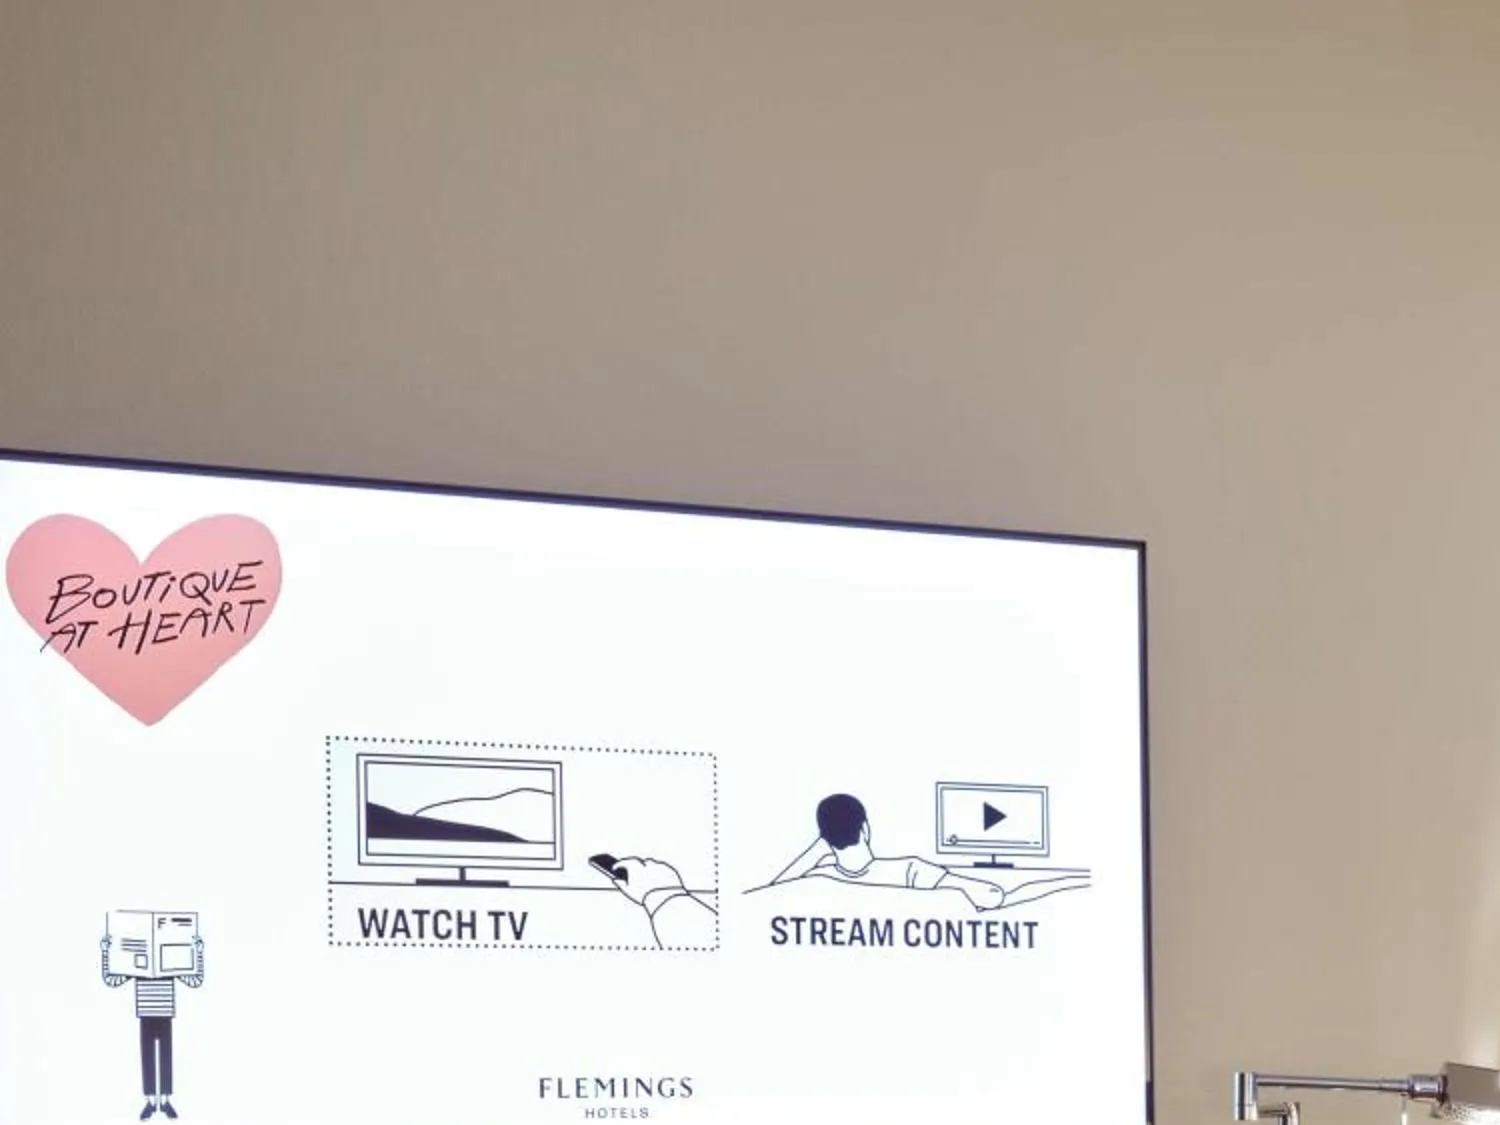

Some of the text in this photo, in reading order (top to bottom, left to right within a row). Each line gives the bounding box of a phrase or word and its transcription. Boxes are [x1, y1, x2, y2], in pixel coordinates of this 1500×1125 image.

[40, 599, 267, 655] AT HEART
[357, 907, 529, 941] WATCH TV
[770, 915, 1039, 949] STREAM CONTENT
[538, 1076, 693, 1099] FLEMINGS
[584, 1107, 650, 1119] HOTELS
